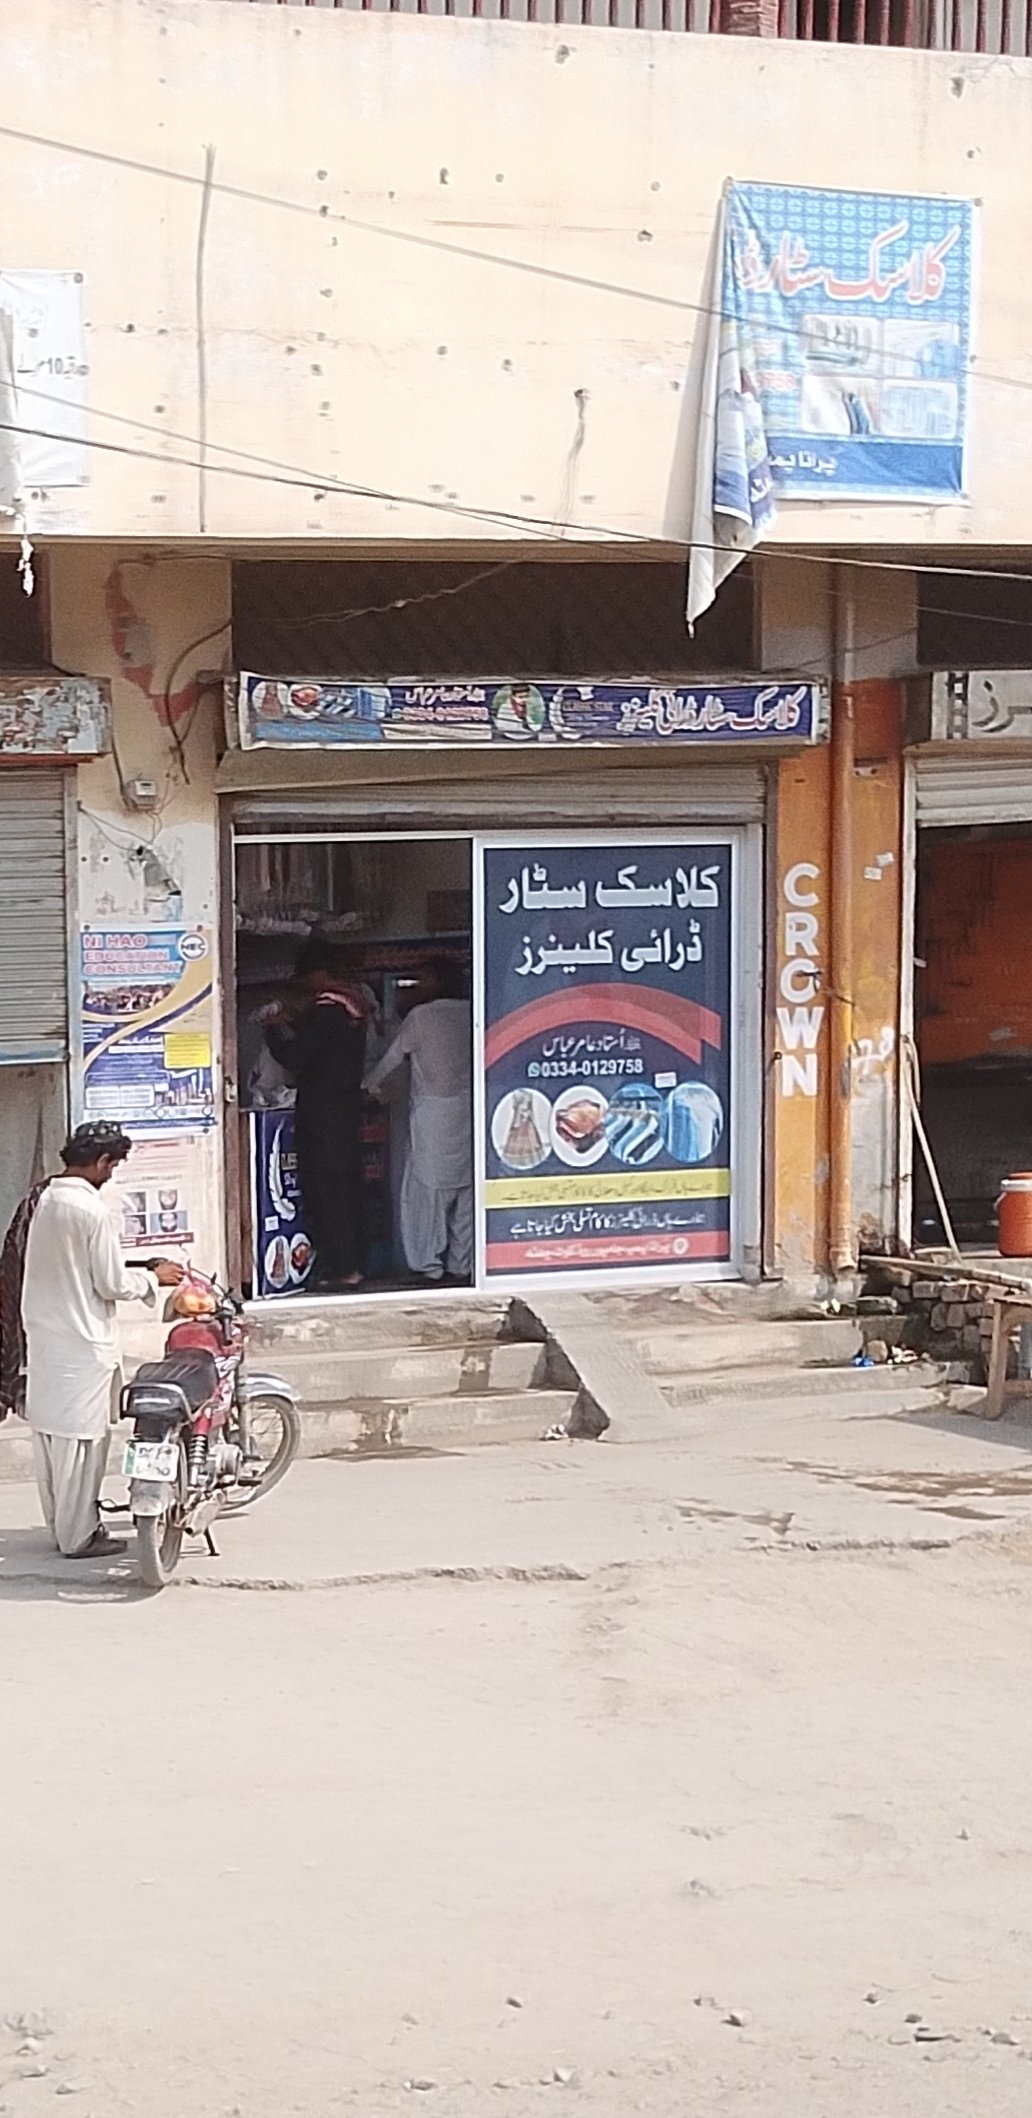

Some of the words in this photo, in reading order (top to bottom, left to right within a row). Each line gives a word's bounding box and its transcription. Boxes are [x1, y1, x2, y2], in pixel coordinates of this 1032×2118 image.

[824, 220, 961, 305] کلاسک
[730, 686, 807, 731] کلاسک
[498, 863, 587, 914] سٹار
[595, 865, 721, 909] کلاسک
[83, 934, 103, 949] NI
[105, 933, 148, 949] HAO
[83, 948, 170, 962] EDUCATION
[181, 943, 206, 952] NEC
[515, 929, 615, 975] کلینرز
[621, 918, 703, 972] ڈرائی
[776, 862, 824, 1097] CROWN
[541, 1058, 644, 1078] 0334-0129758
[509, 1223, 527, 1240] ہے
